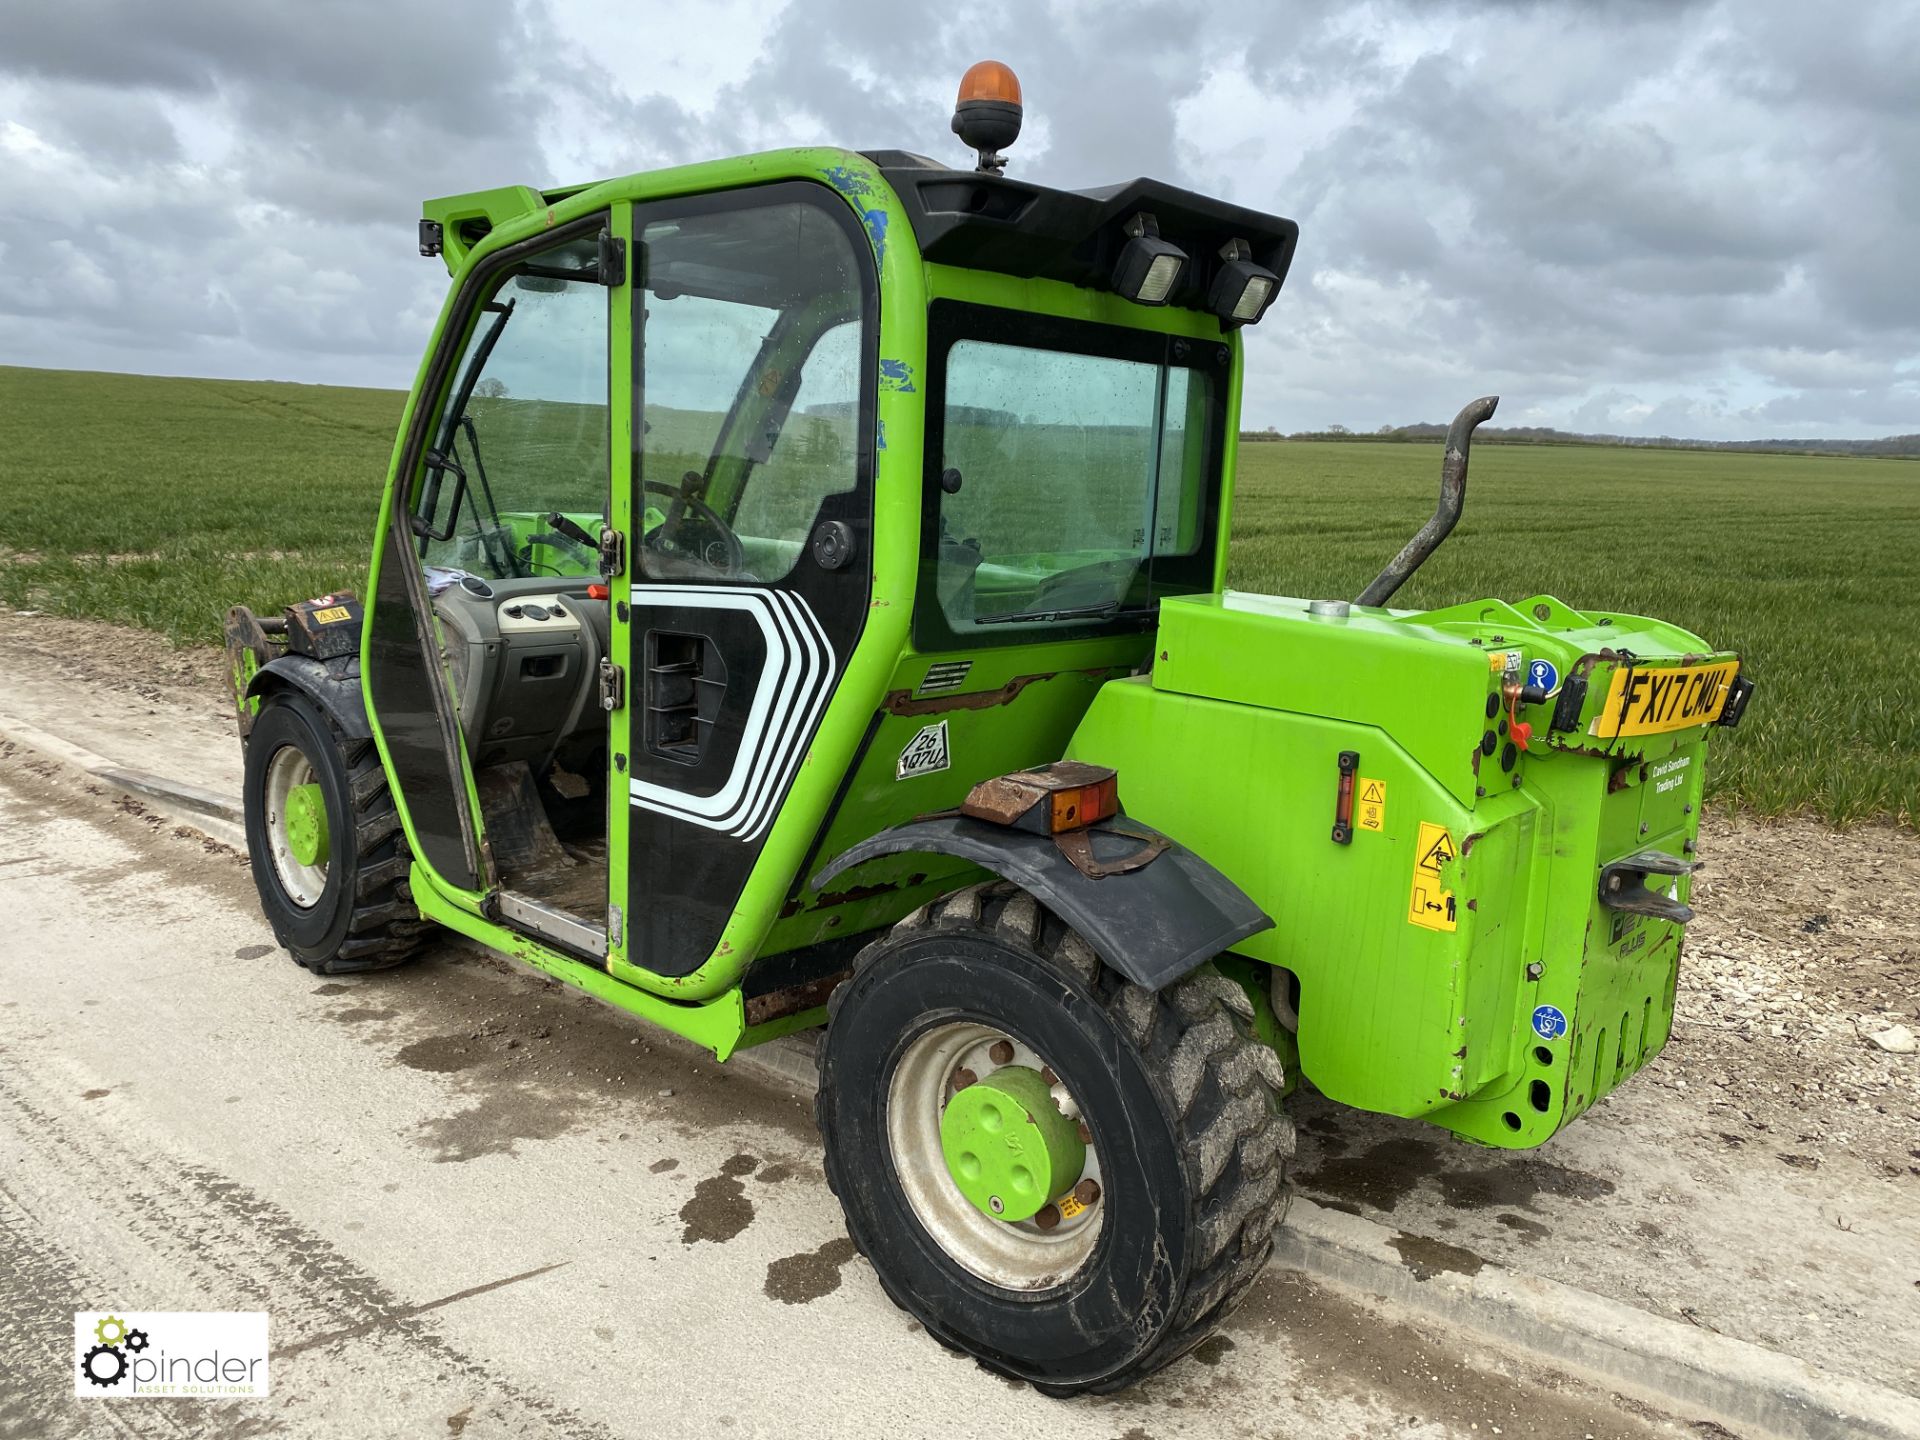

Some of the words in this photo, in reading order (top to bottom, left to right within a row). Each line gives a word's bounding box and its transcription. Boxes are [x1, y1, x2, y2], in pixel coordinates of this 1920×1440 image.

[1621, 674, 1688, 724] FX17
[1682, 669, 1727, 718] CMU
[915, 733, 937, 752] 26
[1652, 763, 1668, 778] David
[1668, 757, 1690, 772] Sandham
[1656, 778, 1674, 793] Trading
[1674, 773, 1684, 787] Ltd
[1620, 930, 1647, 957] PLUS
